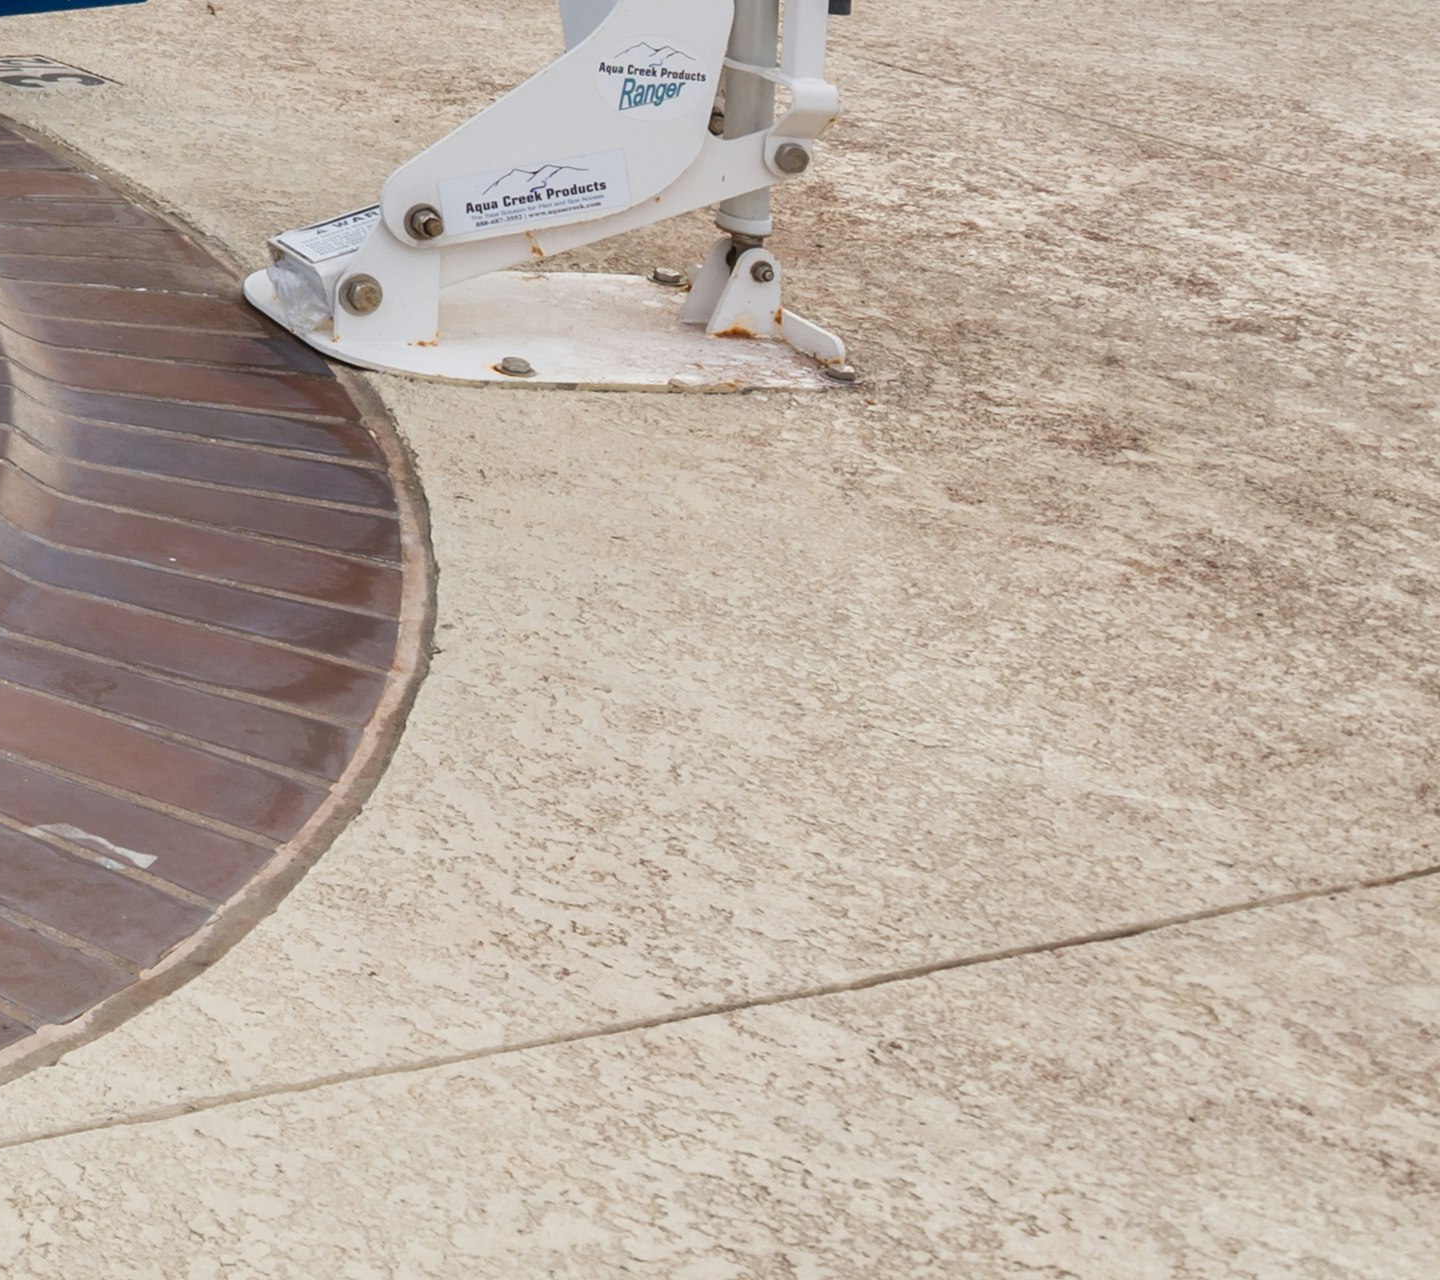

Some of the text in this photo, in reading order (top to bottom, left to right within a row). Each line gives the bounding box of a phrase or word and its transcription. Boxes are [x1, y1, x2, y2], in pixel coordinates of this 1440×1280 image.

[599, 62, 706, 82] Aqua Creek Products
[619, 78, 686, 110] Ranger
[465, 181, 607, 215] Aqua Creek Products
